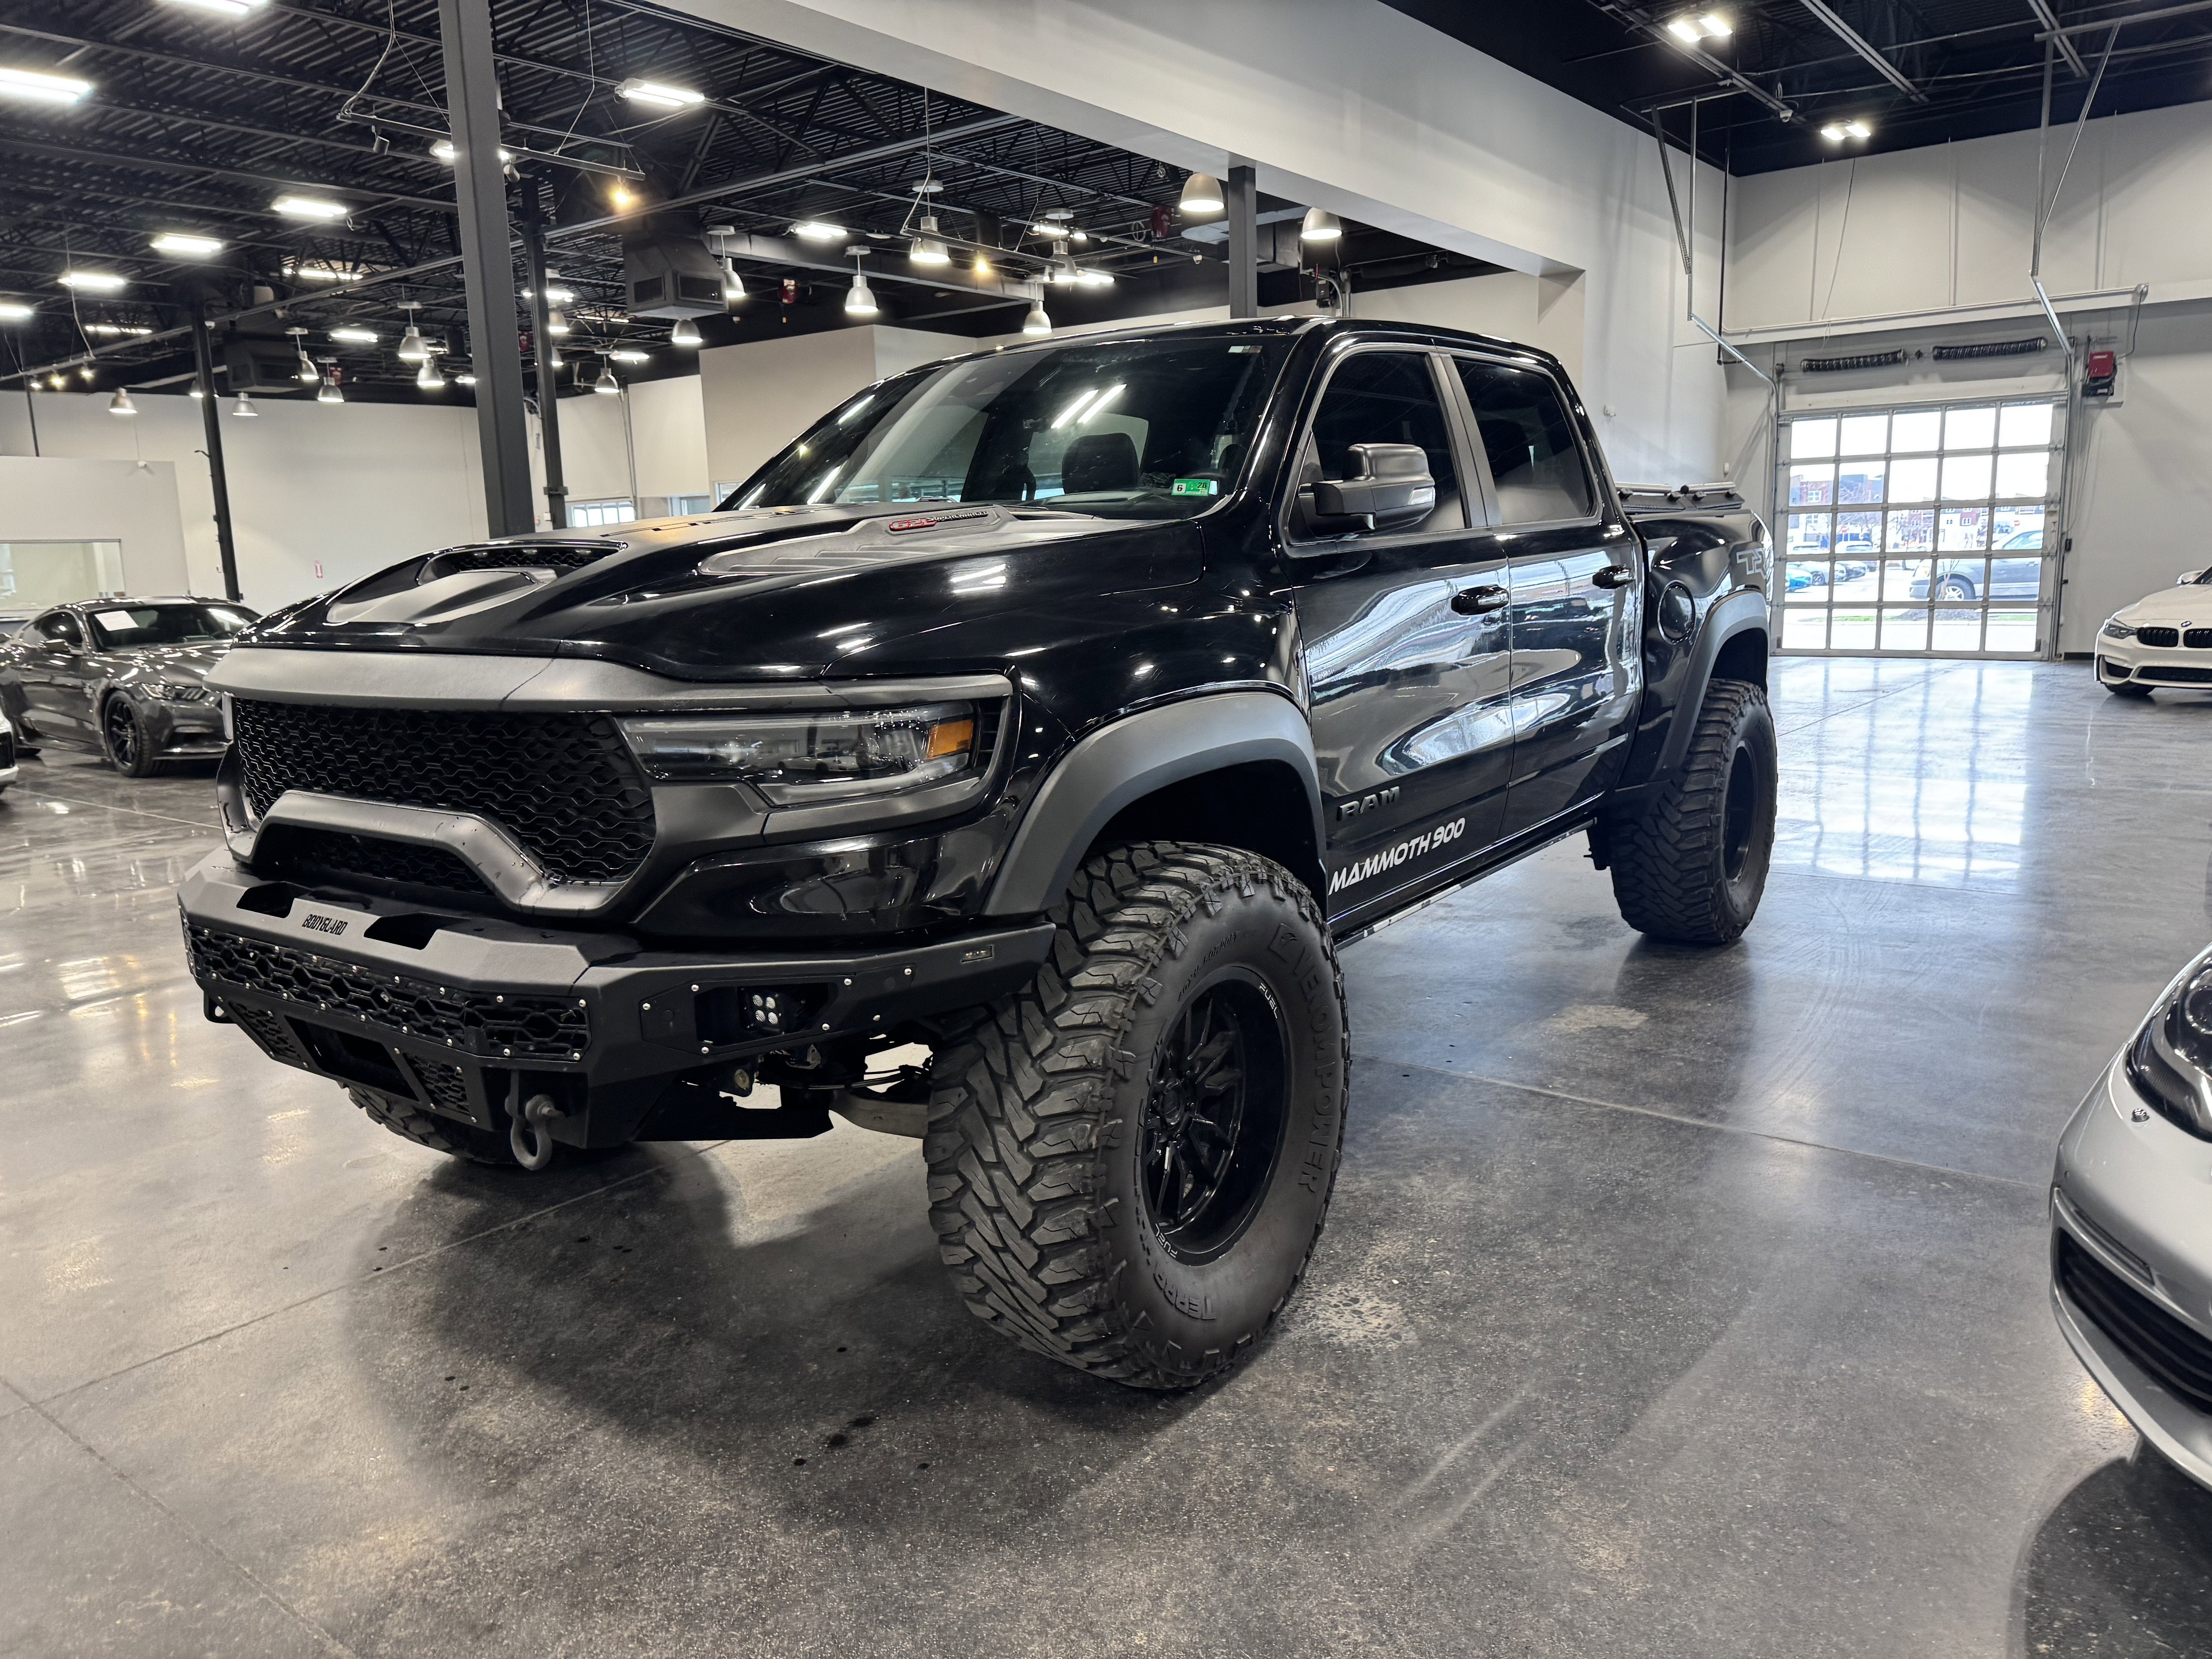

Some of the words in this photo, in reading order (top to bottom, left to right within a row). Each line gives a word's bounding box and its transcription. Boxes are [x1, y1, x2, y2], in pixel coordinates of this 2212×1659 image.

[1736, 548, 1770, 580] TR
[1336, 786, 1400, 821] RAM
[1328, 832, 1432, 895] MAMMOTH
[1432, 817, 1465, 849] 900
[302, 914, 348, 935] BODYGUARD
[1259, 983, 1277, 1019] FUEL
[1156, 1223, 1177, 1258] FUEL
[1153, 1262, 1217, 1321] TERRA
